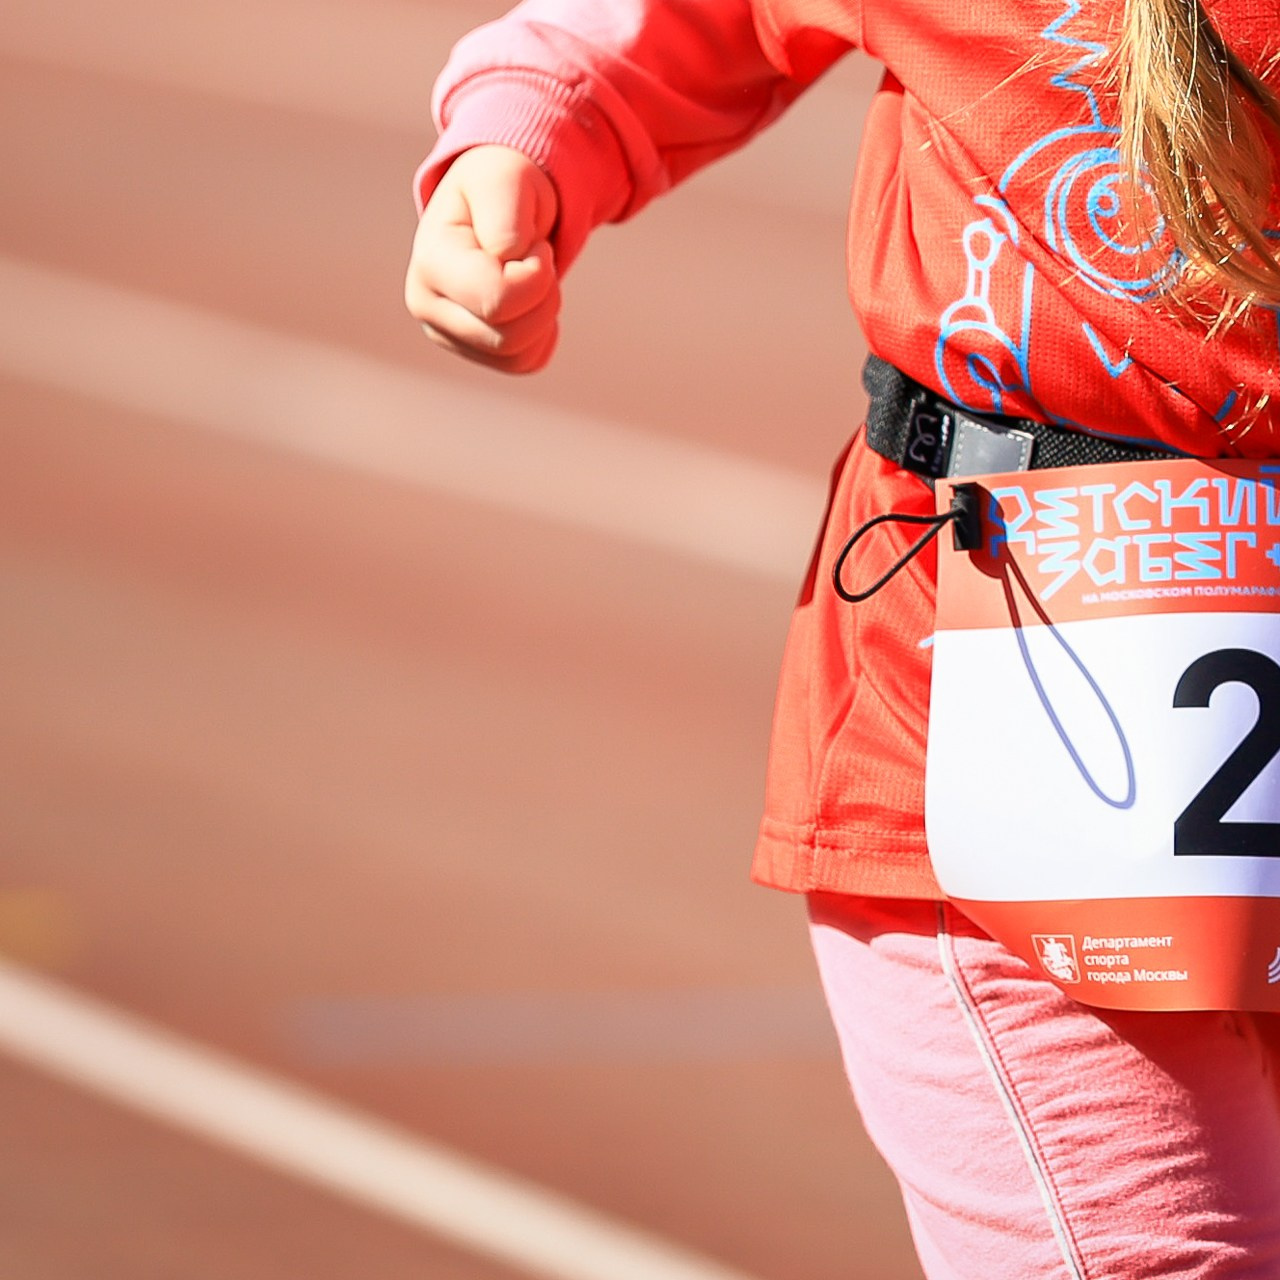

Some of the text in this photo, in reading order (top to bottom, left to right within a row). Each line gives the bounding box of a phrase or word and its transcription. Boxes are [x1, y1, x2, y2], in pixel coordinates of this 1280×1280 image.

[1036, 532, 1257, 601] ЗАБЕГ
[1081, 593, 1100, 604] НА
[1101, 586, 1193, 602] МОСКОВСКОМ
[1082, 935, 1173, 951] Департамент
[1084, 953, 1129, 968] спорта
[1087, 969, 1188, 984] города Москвы
